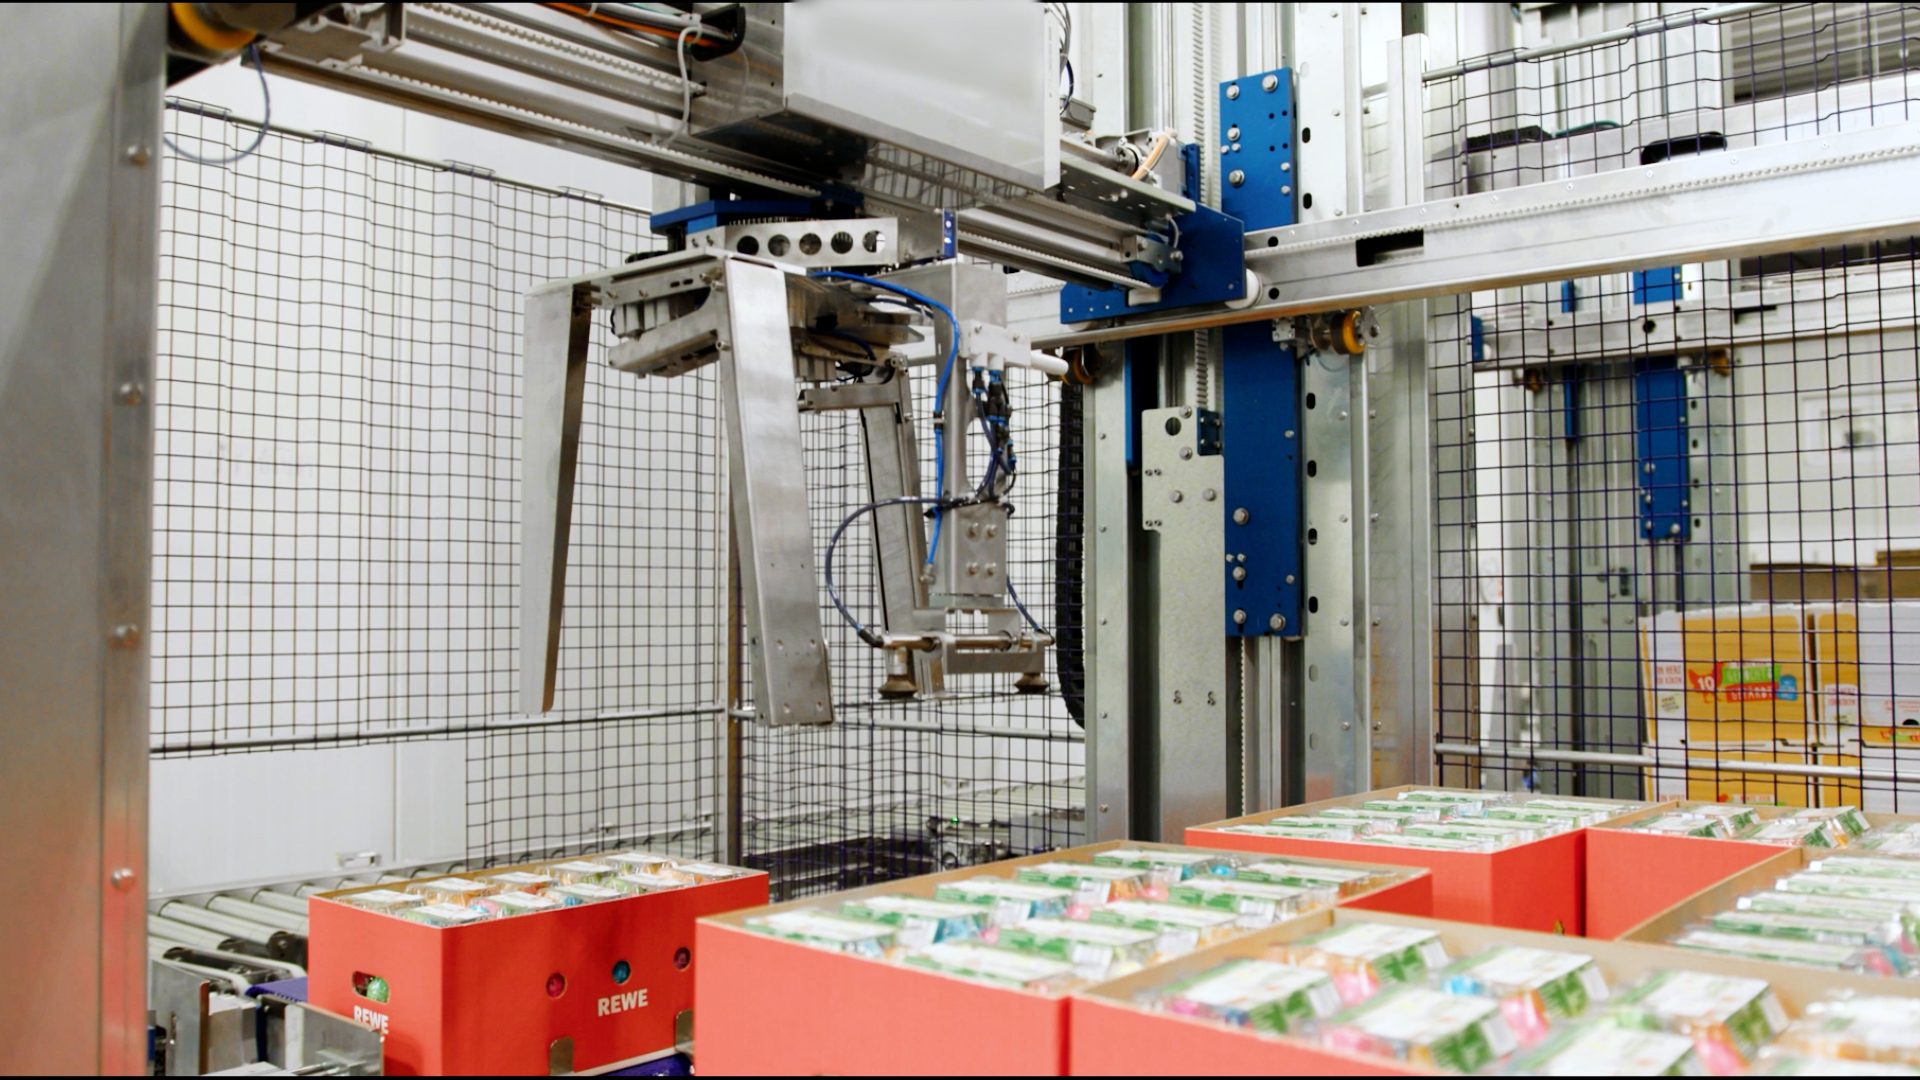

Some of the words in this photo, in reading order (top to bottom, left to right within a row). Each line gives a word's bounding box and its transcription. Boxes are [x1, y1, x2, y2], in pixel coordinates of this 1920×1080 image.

[1697, 676, 1715, 691] 10
[597, 988, 648, 1017] REWE
[353, 1005, 389, 1034] REWE
